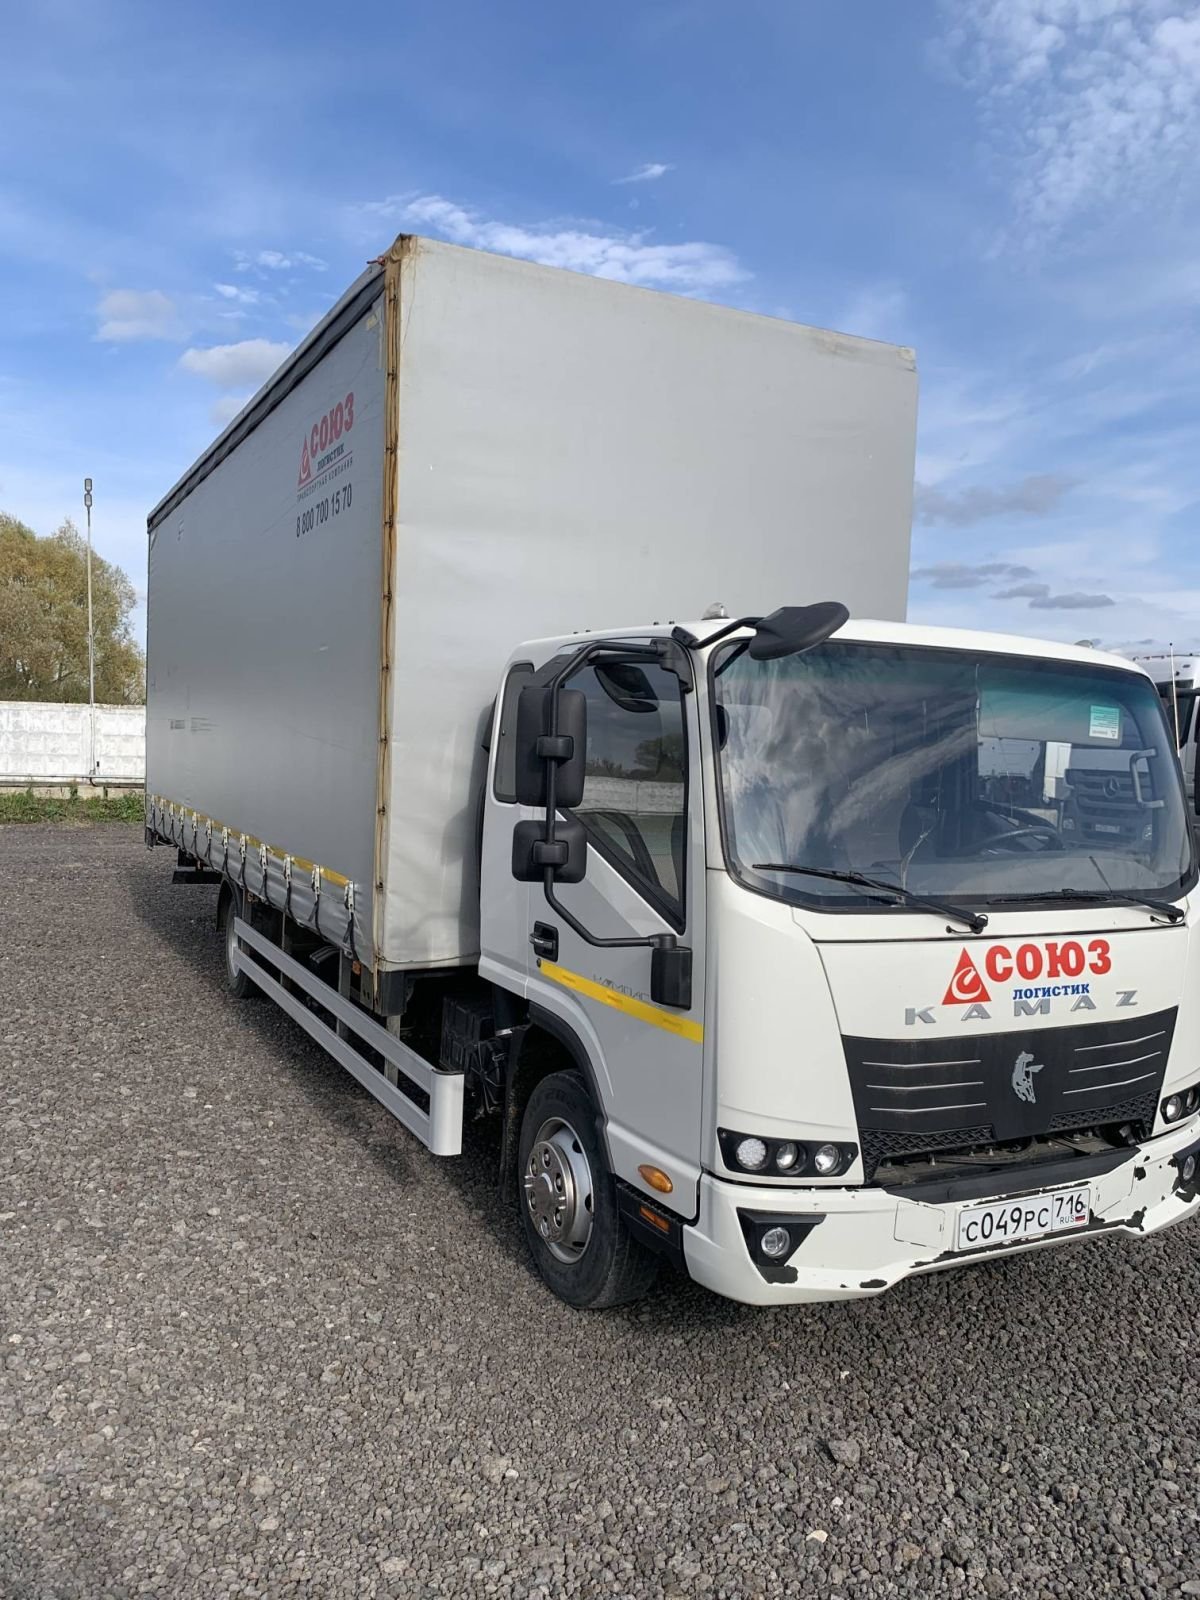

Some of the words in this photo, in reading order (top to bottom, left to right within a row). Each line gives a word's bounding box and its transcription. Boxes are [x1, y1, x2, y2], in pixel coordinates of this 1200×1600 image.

[310, 392, 354, 459] СОЮЗ
[296, 516, 301, 538] 8
[302, 507, 314, 535] 800
[316, 497, 329, 527] 700
[331, 490, 341, 517] 15
[342, 482, 352, 511] 70
[985, 939, 1112, 983] СОЮЗ
[905, 990, 1138, 1025] KAMAZ
[1012, 983, 1090, 1000] ЛОГИСТИК
[966, 1207, 1049, 1242] С049РС
[1055, 1193, 1084, 1218] 716
[1060, 1214, 1075, 1225] RUS
